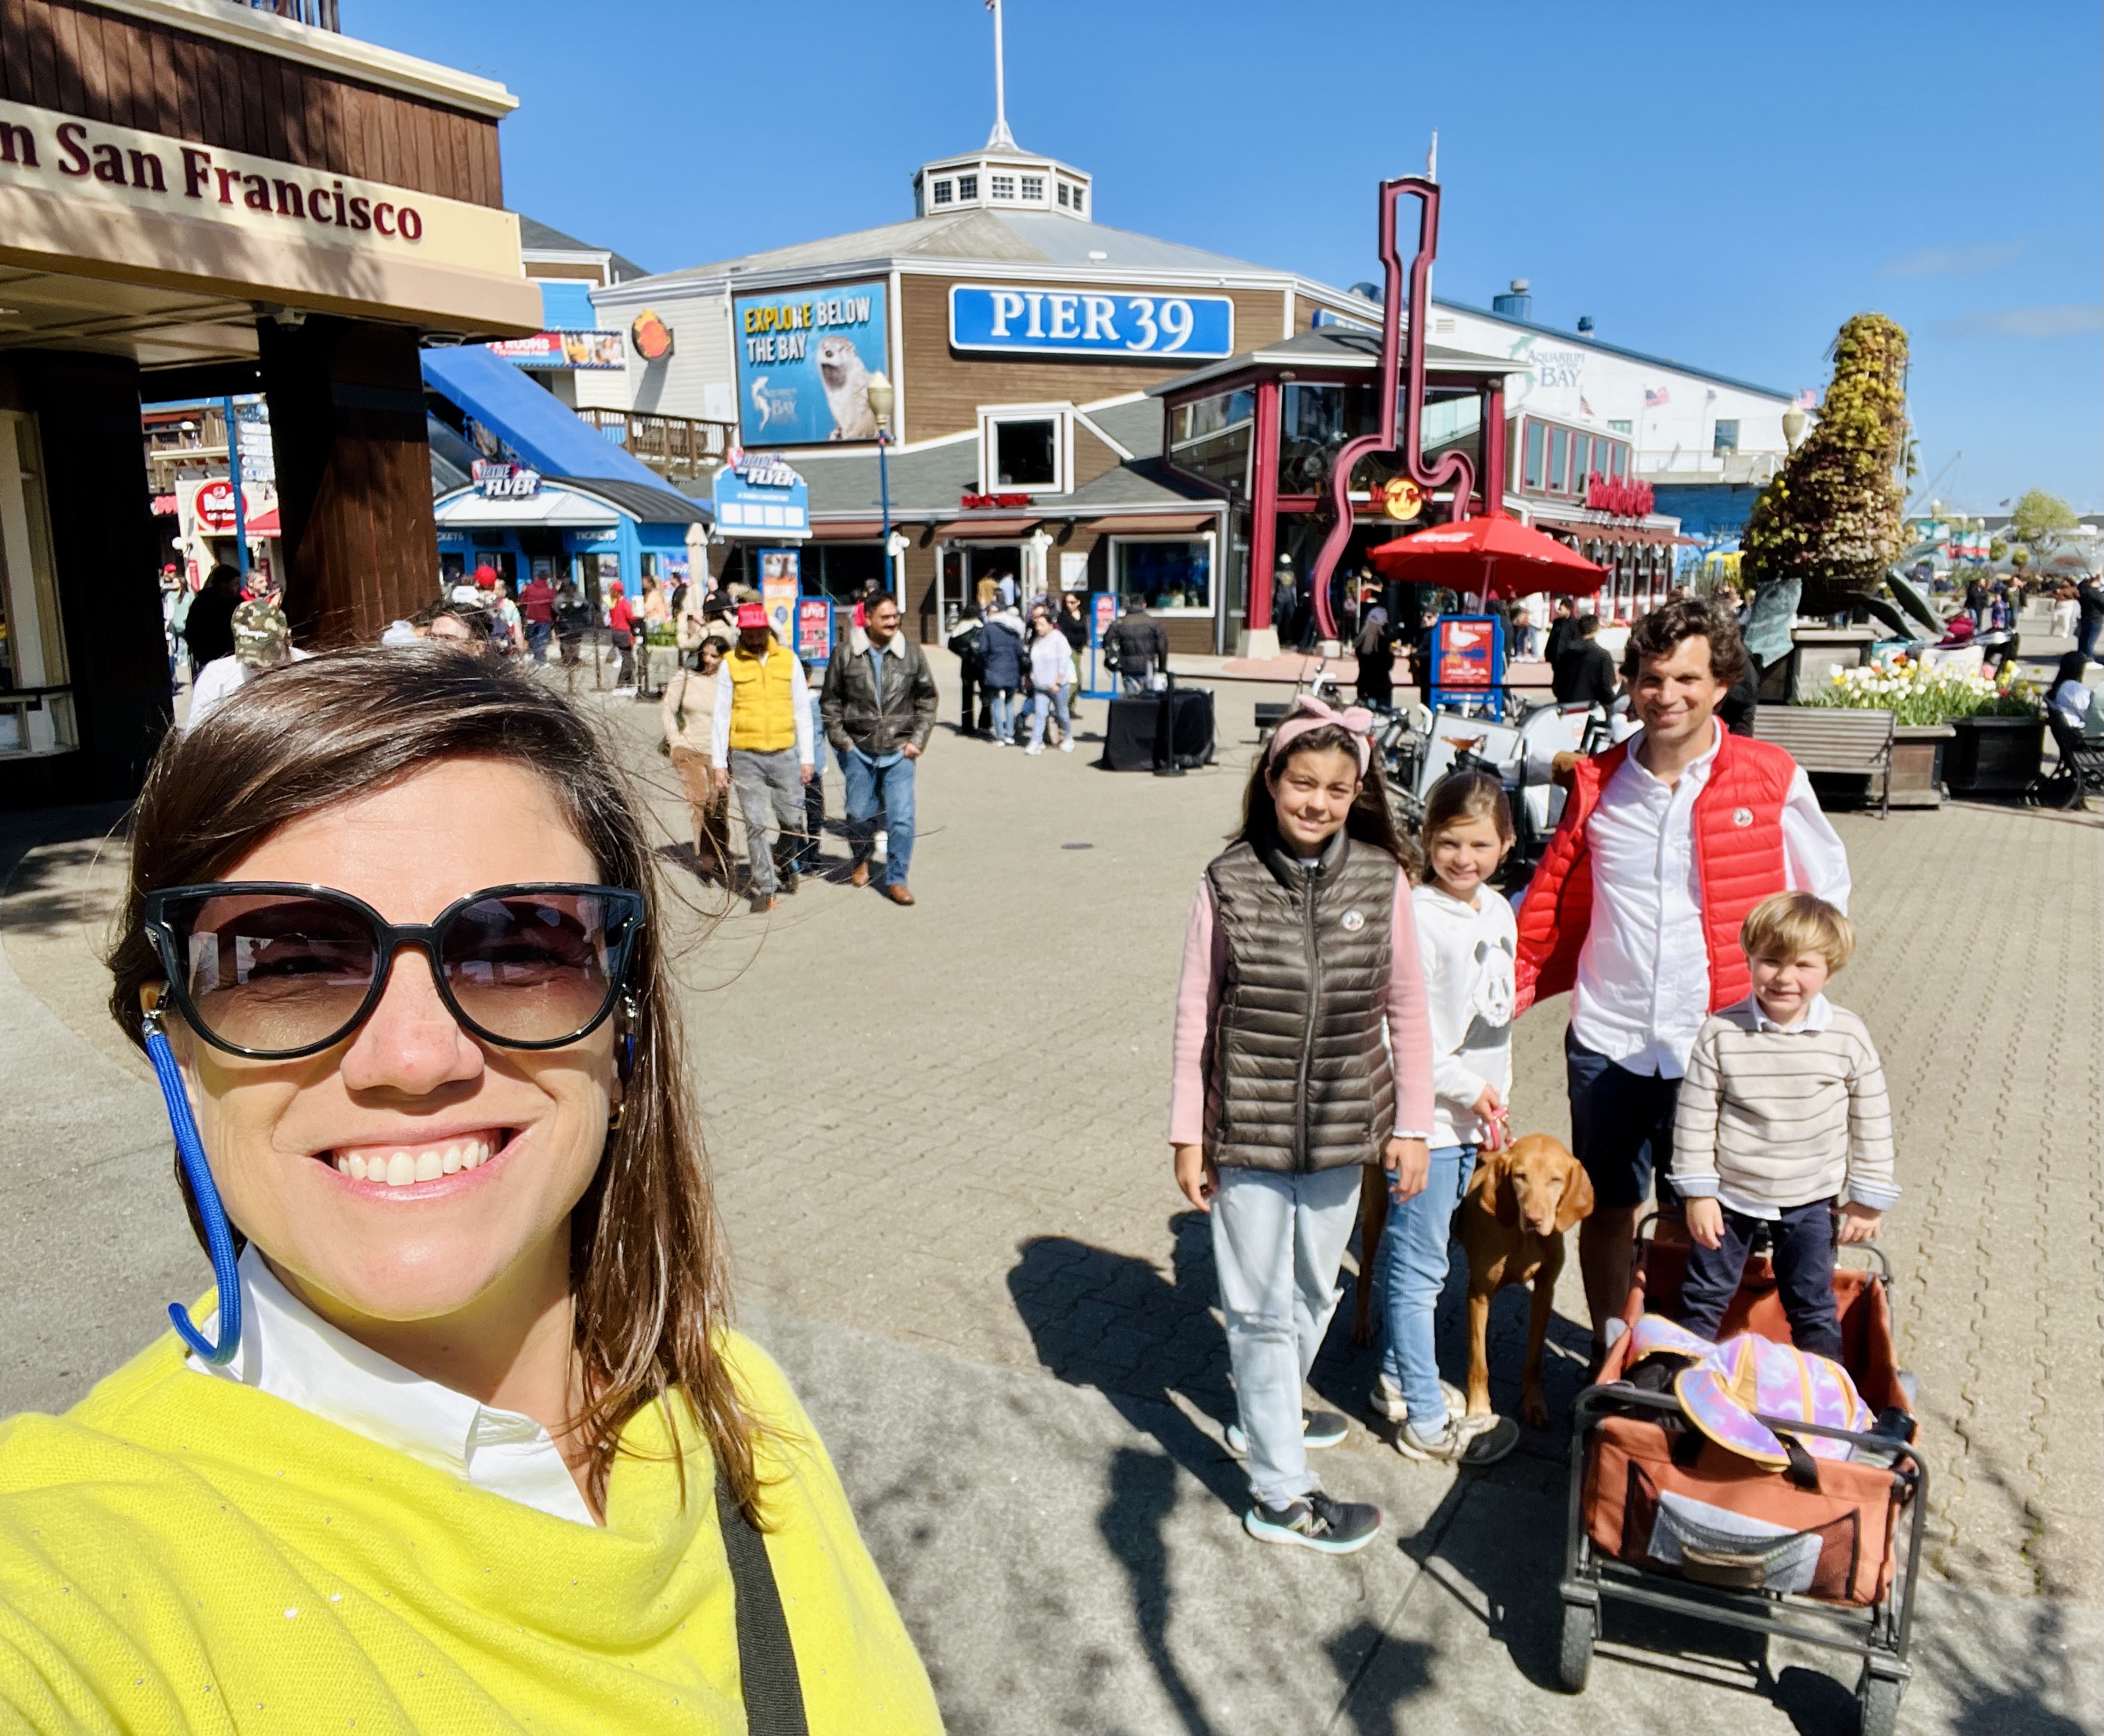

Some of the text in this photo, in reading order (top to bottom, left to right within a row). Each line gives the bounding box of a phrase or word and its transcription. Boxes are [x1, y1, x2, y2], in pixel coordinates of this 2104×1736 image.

[0, 121, 423, 240] n San Francisco
[816, 296, 870, 327] BELOW
[990, 291, 1194, 352] PIER 39
[747, 333, 808, 363] THE BAY
[1540, 367, 1581, 388] BAY
[485, 478, 536, 495] FLYER
[748, 467, 797, 486] FLYER
